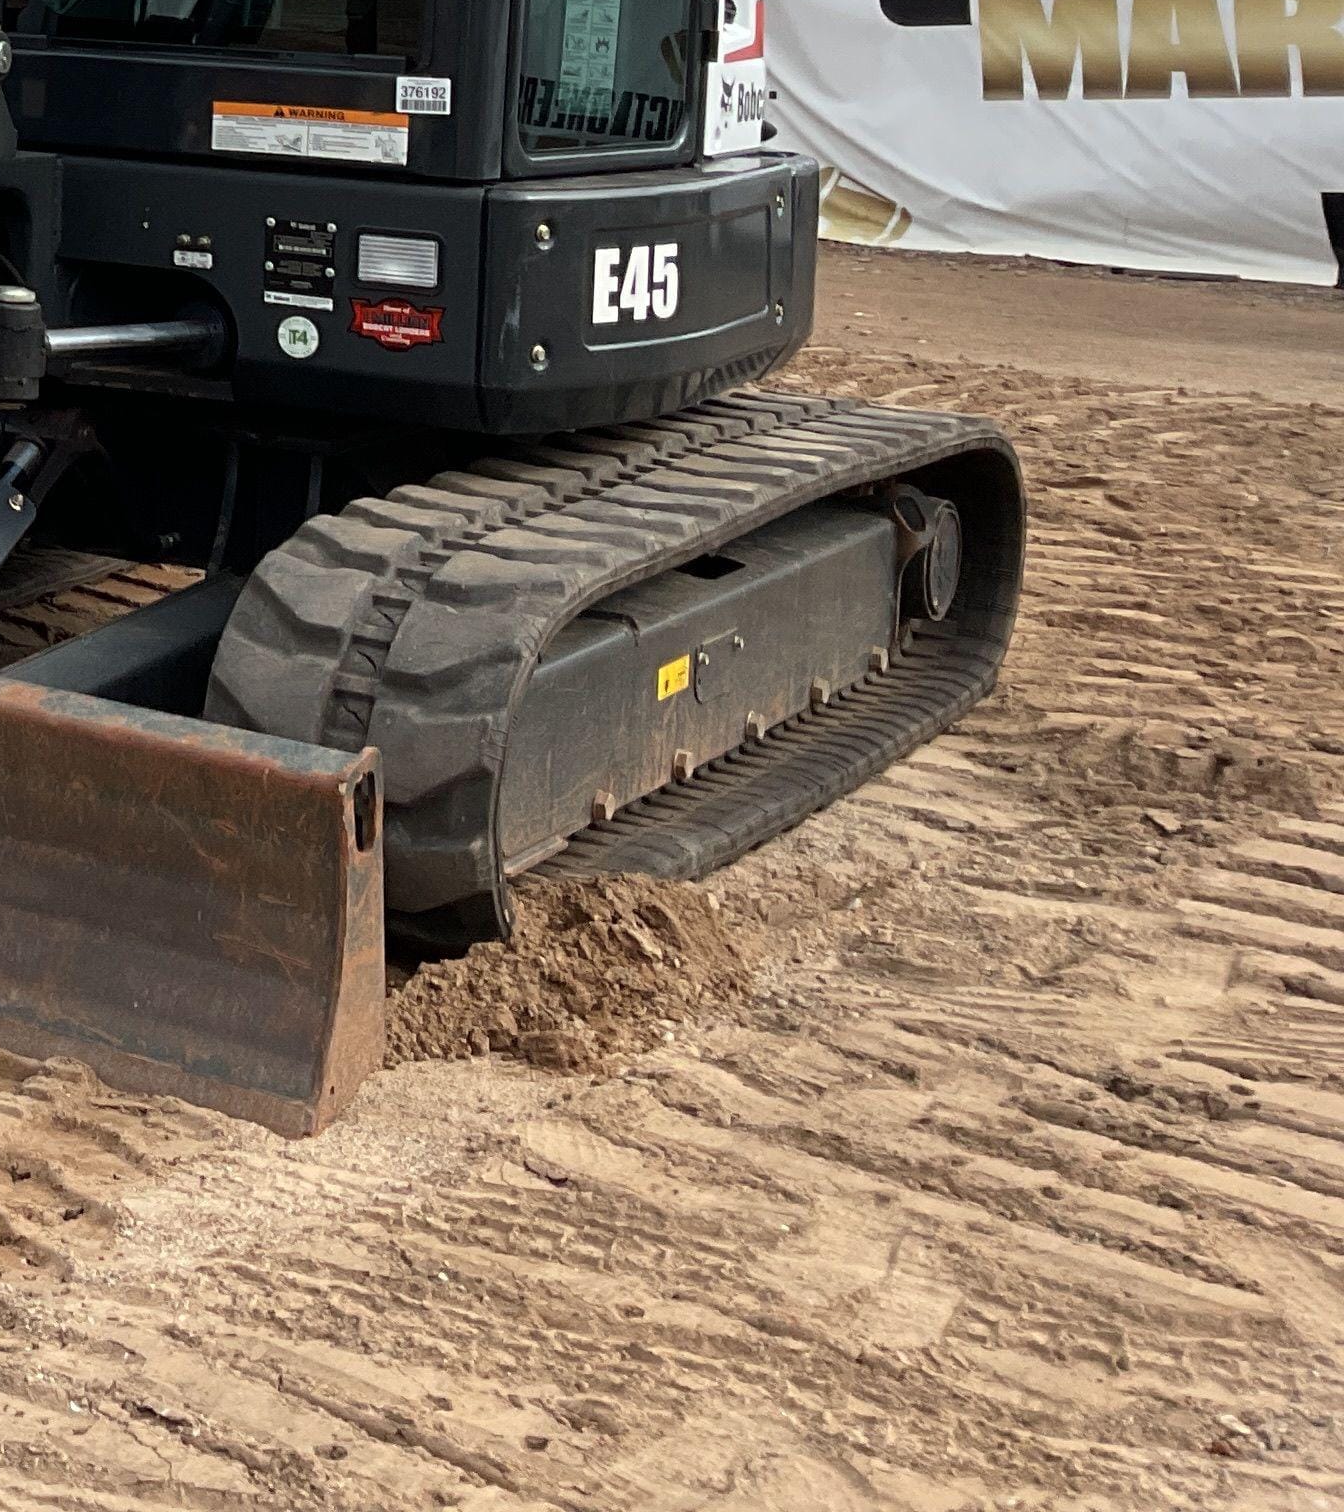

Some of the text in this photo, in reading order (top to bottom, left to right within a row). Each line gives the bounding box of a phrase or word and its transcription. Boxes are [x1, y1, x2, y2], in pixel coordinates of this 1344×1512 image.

[400, 85, 447, 100] 376192
[287, 107, 346, 121] WARNING
[592, 242, 680, 324] E45
